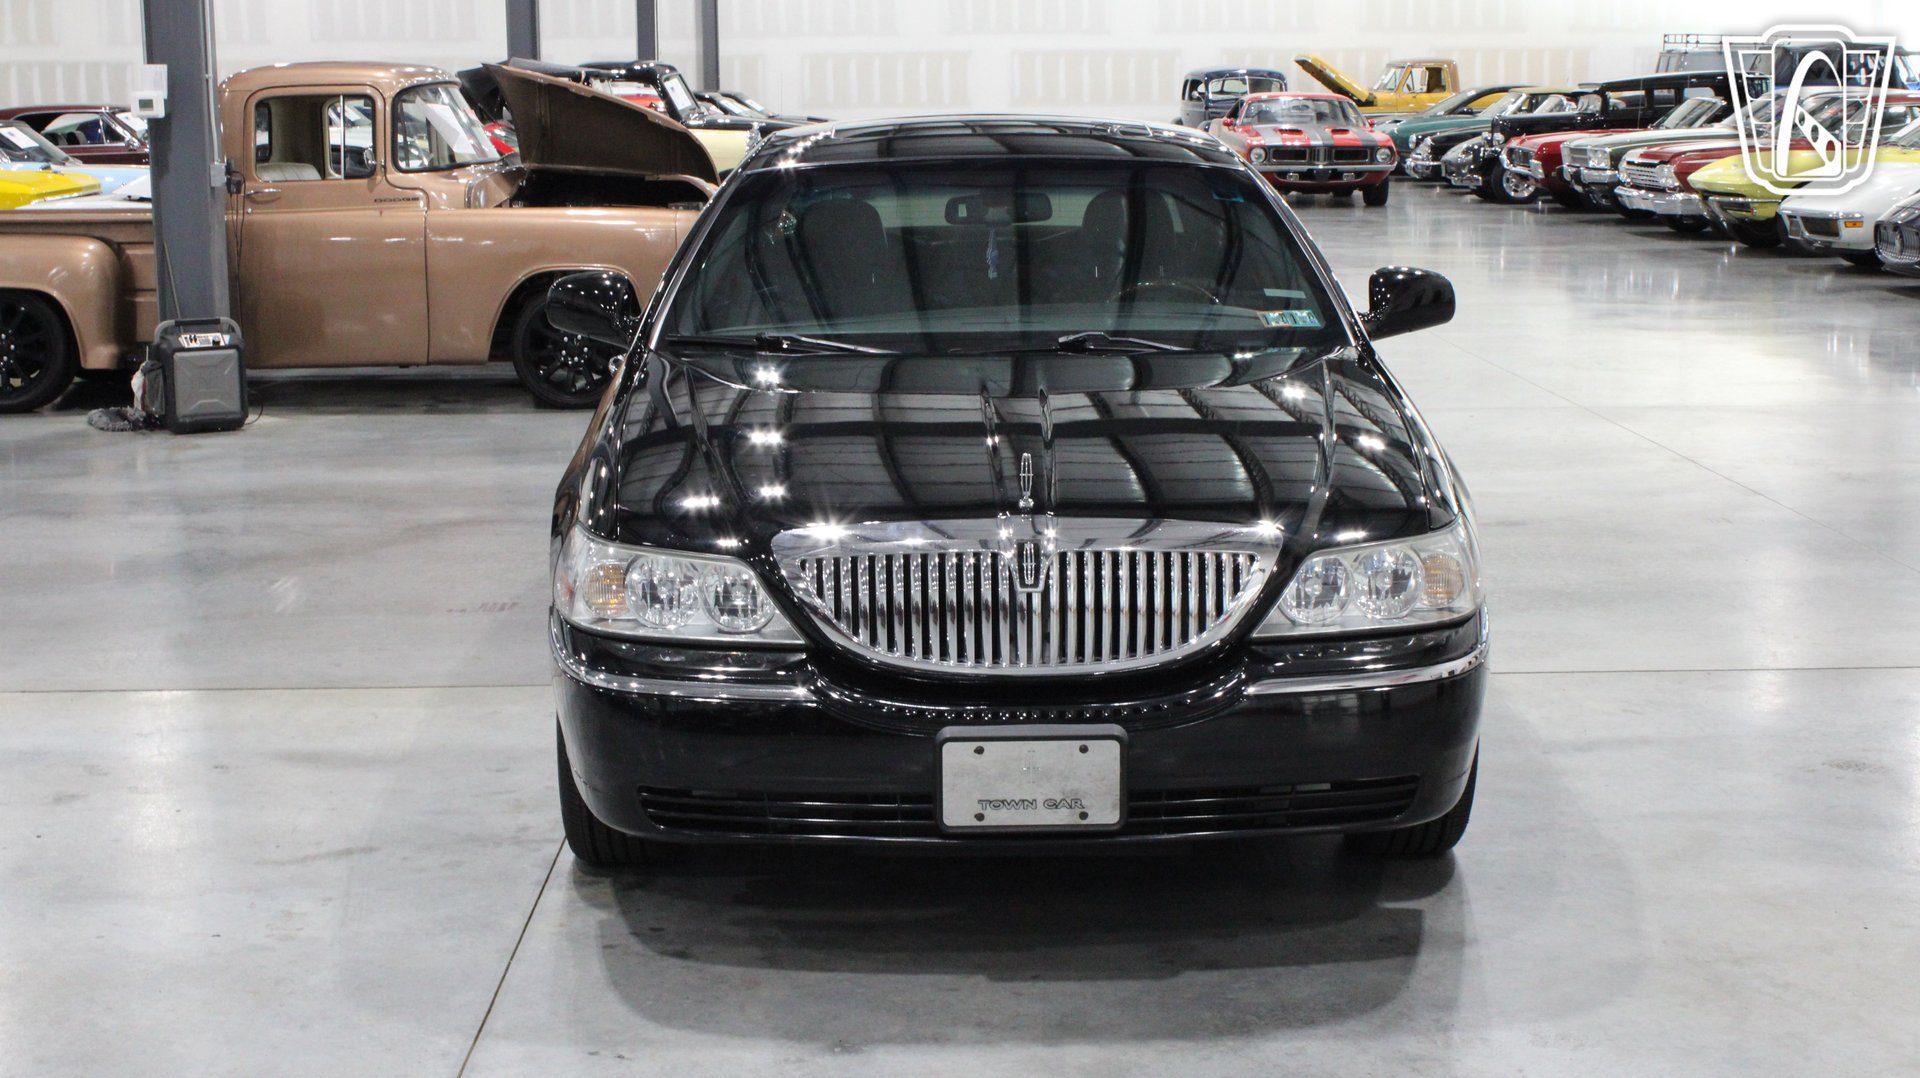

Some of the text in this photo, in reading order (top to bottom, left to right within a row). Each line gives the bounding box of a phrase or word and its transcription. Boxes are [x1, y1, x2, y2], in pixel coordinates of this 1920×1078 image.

[373, 196, 420, 204] DODGE
[977, 798, 1086, 811] TOWN CAR
